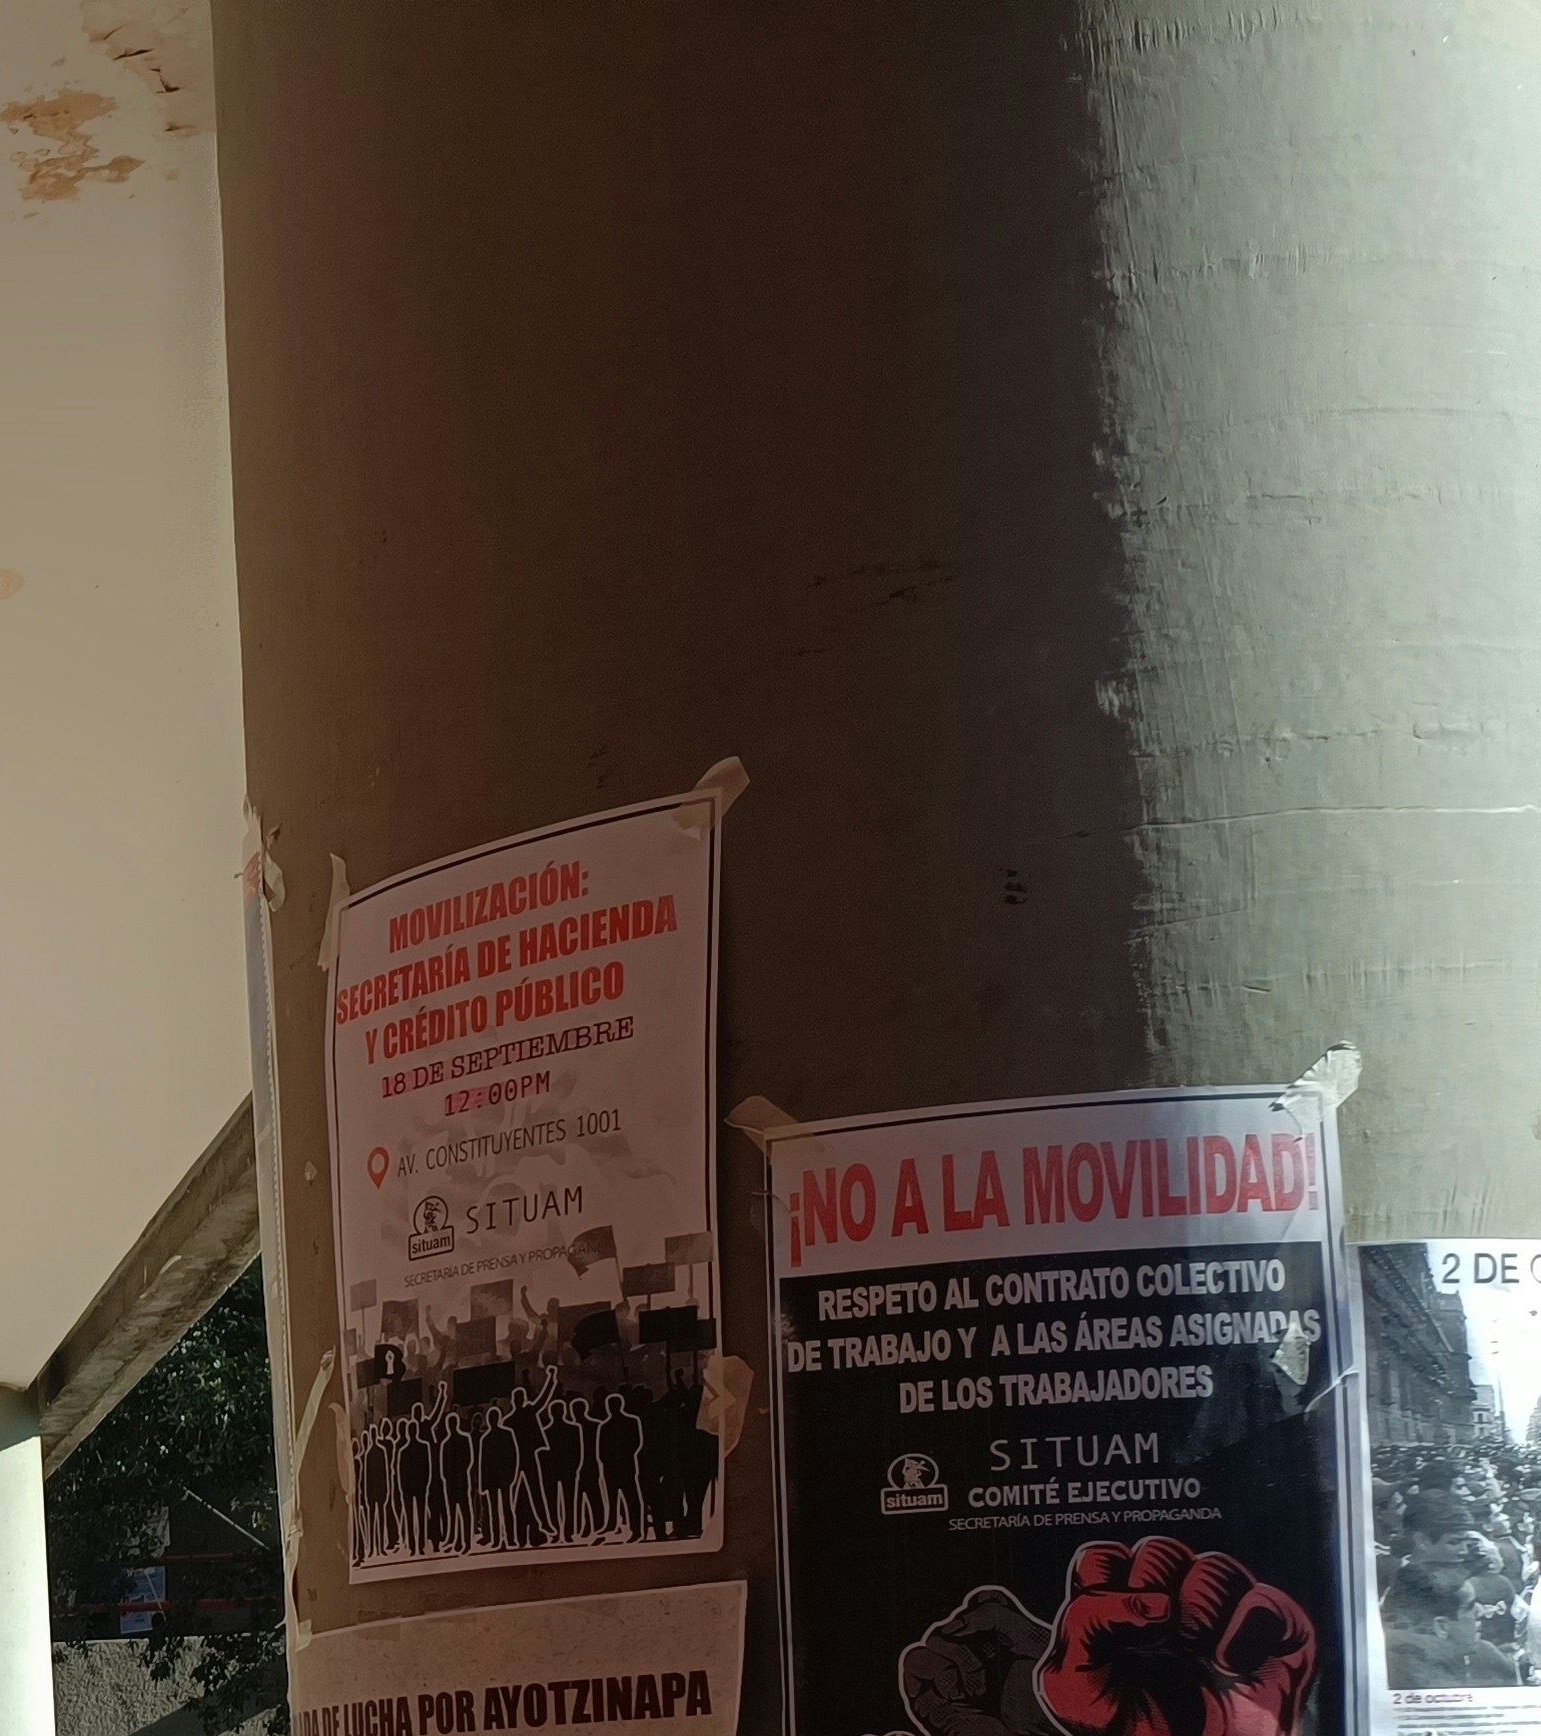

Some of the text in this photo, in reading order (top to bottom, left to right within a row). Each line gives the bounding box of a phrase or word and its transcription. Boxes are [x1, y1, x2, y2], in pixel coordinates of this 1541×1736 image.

[389, 860, 588, 953] MOVILIZACIÓN:
[336, 895, 677, 1024] SECRETARÍA DE HACIENDA
[366, 961, 625, 1065] Y CRÉDITO PÚBLICO
[382, 1016, 634, 1098] 18 DE SEPTIEMBRE
[444, 1070, 551, 1116] 12:00PM
[398, 1109, 621, 1178] AV. CONSTITUYENTES 1001
[466, 1186, 584, 1235] SITUAM
[790, 1132, 1319, 1267] ¡NO A LA MOVILIDAD!
[412, 1235, 451, 1254] situam
[461, 1262, 475, 1276] DE
[476, 1254, 517, 1272] PRENSA
[519, 1252, 527, 1265] Y
[1442, 1253, 1461, 1285] 2
[1473, 1252, 1520, 1285] DE
[819, 1259, 1285, 1320] RESPETO AL CONTRATO COLECTIVO
[787, 1310, 1320, 1372] DE TRABAJO Y A LAS ÁREAS ASIGNADAS
[900, 1366, 1213, 1413] DE LOS TRABAJADORES
[989, 1433, 1159, 1470] SITUAM
[886, 1492, 943, 1508] situam
[969, 1478, 1201, 1508] COMITÉ EJECUTIVO
[949, 1507, 1222, 1531] SECRETARÍA DE PRENSA Y PROPAGANDA
[419, 1689, 475, 1736] POR
[483, 1670, 712, 1731] AYOTZINAPA
[1393, 1693, 1402, 1704] 2
[1405, 1692, 1421, 1704] de
